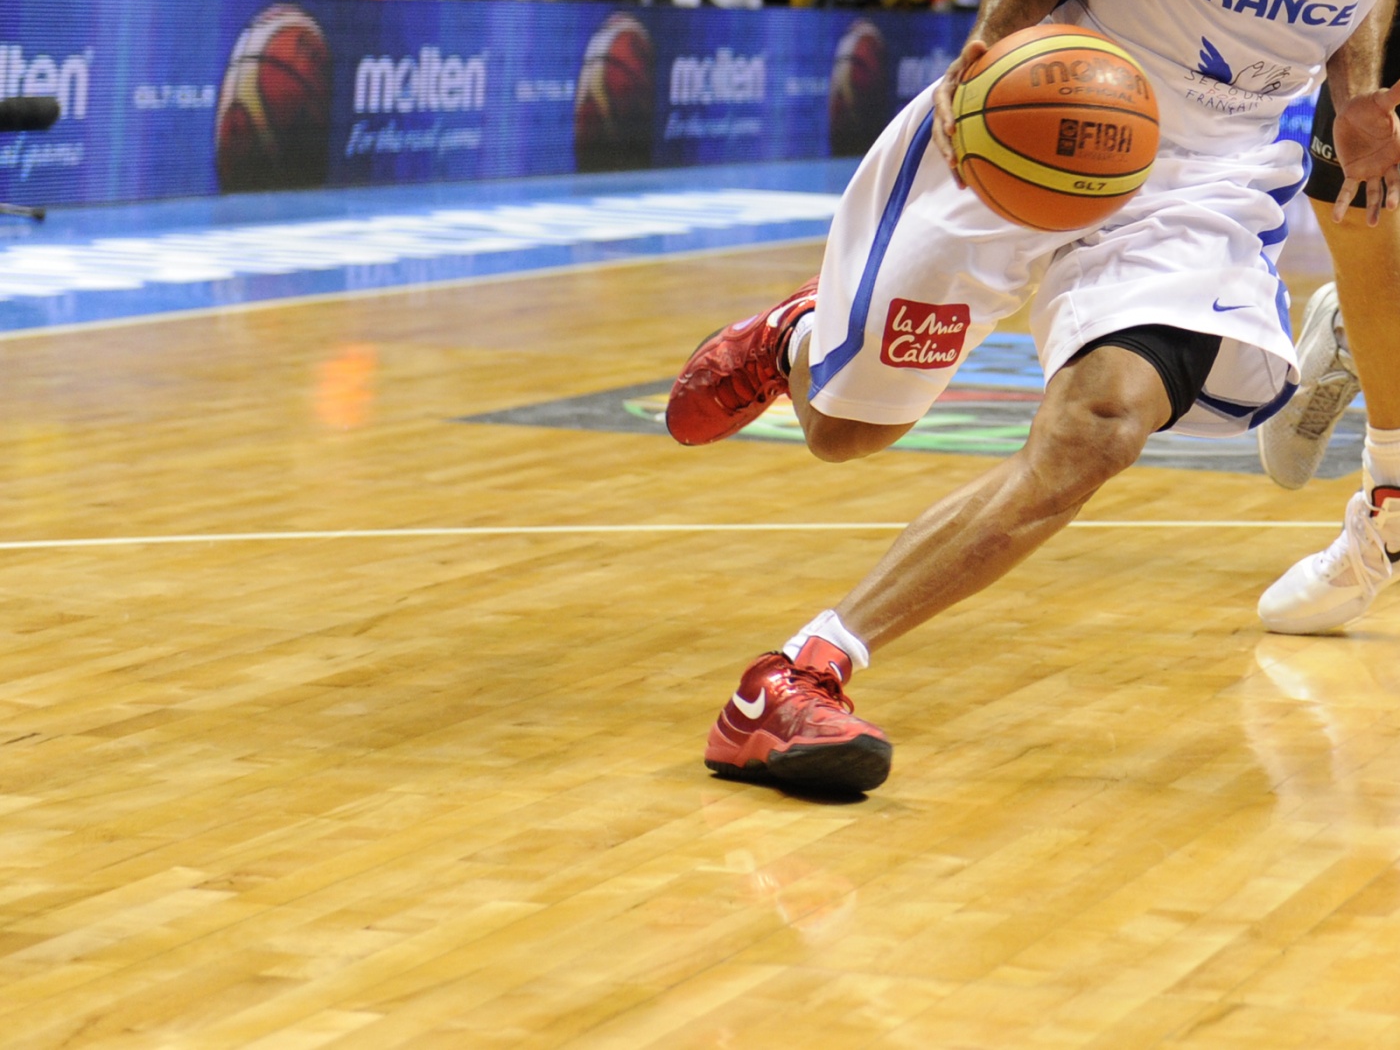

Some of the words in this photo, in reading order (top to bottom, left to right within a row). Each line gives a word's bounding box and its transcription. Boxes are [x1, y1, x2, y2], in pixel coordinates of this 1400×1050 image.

[354, 45, 486, 113] molten
[1030, 57, 1150, 101] molten
[1058, 86, 1135, 104] OFFICIAL
[1078, 120, 1133, 153] FIBA
[1073, 180, 1107, 191] GL7
[892, 305, 913, 333] la
[914, 312, 964, 336] Mie
[888, 334, 957, 364] Câline
